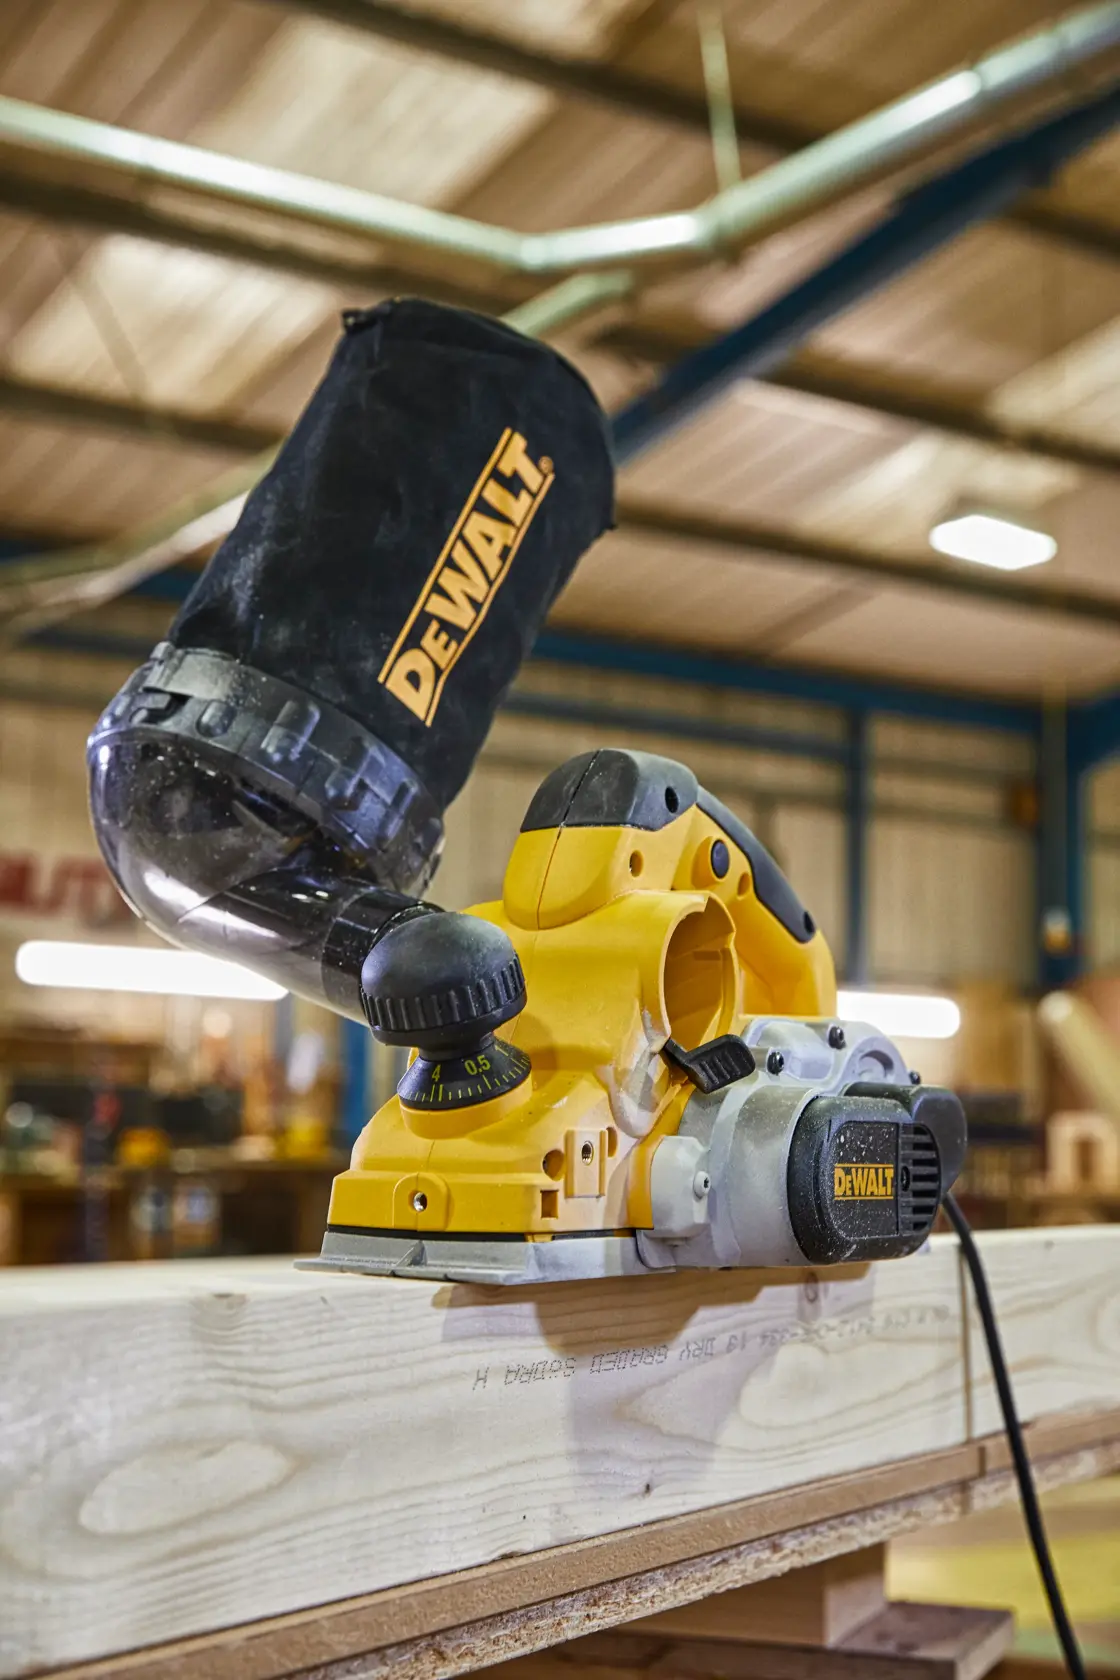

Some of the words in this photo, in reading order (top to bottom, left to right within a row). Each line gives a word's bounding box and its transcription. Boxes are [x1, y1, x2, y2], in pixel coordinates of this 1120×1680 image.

[431, 1064, 442, 1082] 4
[464, 1055, 492, 1076] 0.5
[589, 1344, 669, 1374] GRADED
[679, 1336, 717, 1361] DRY
